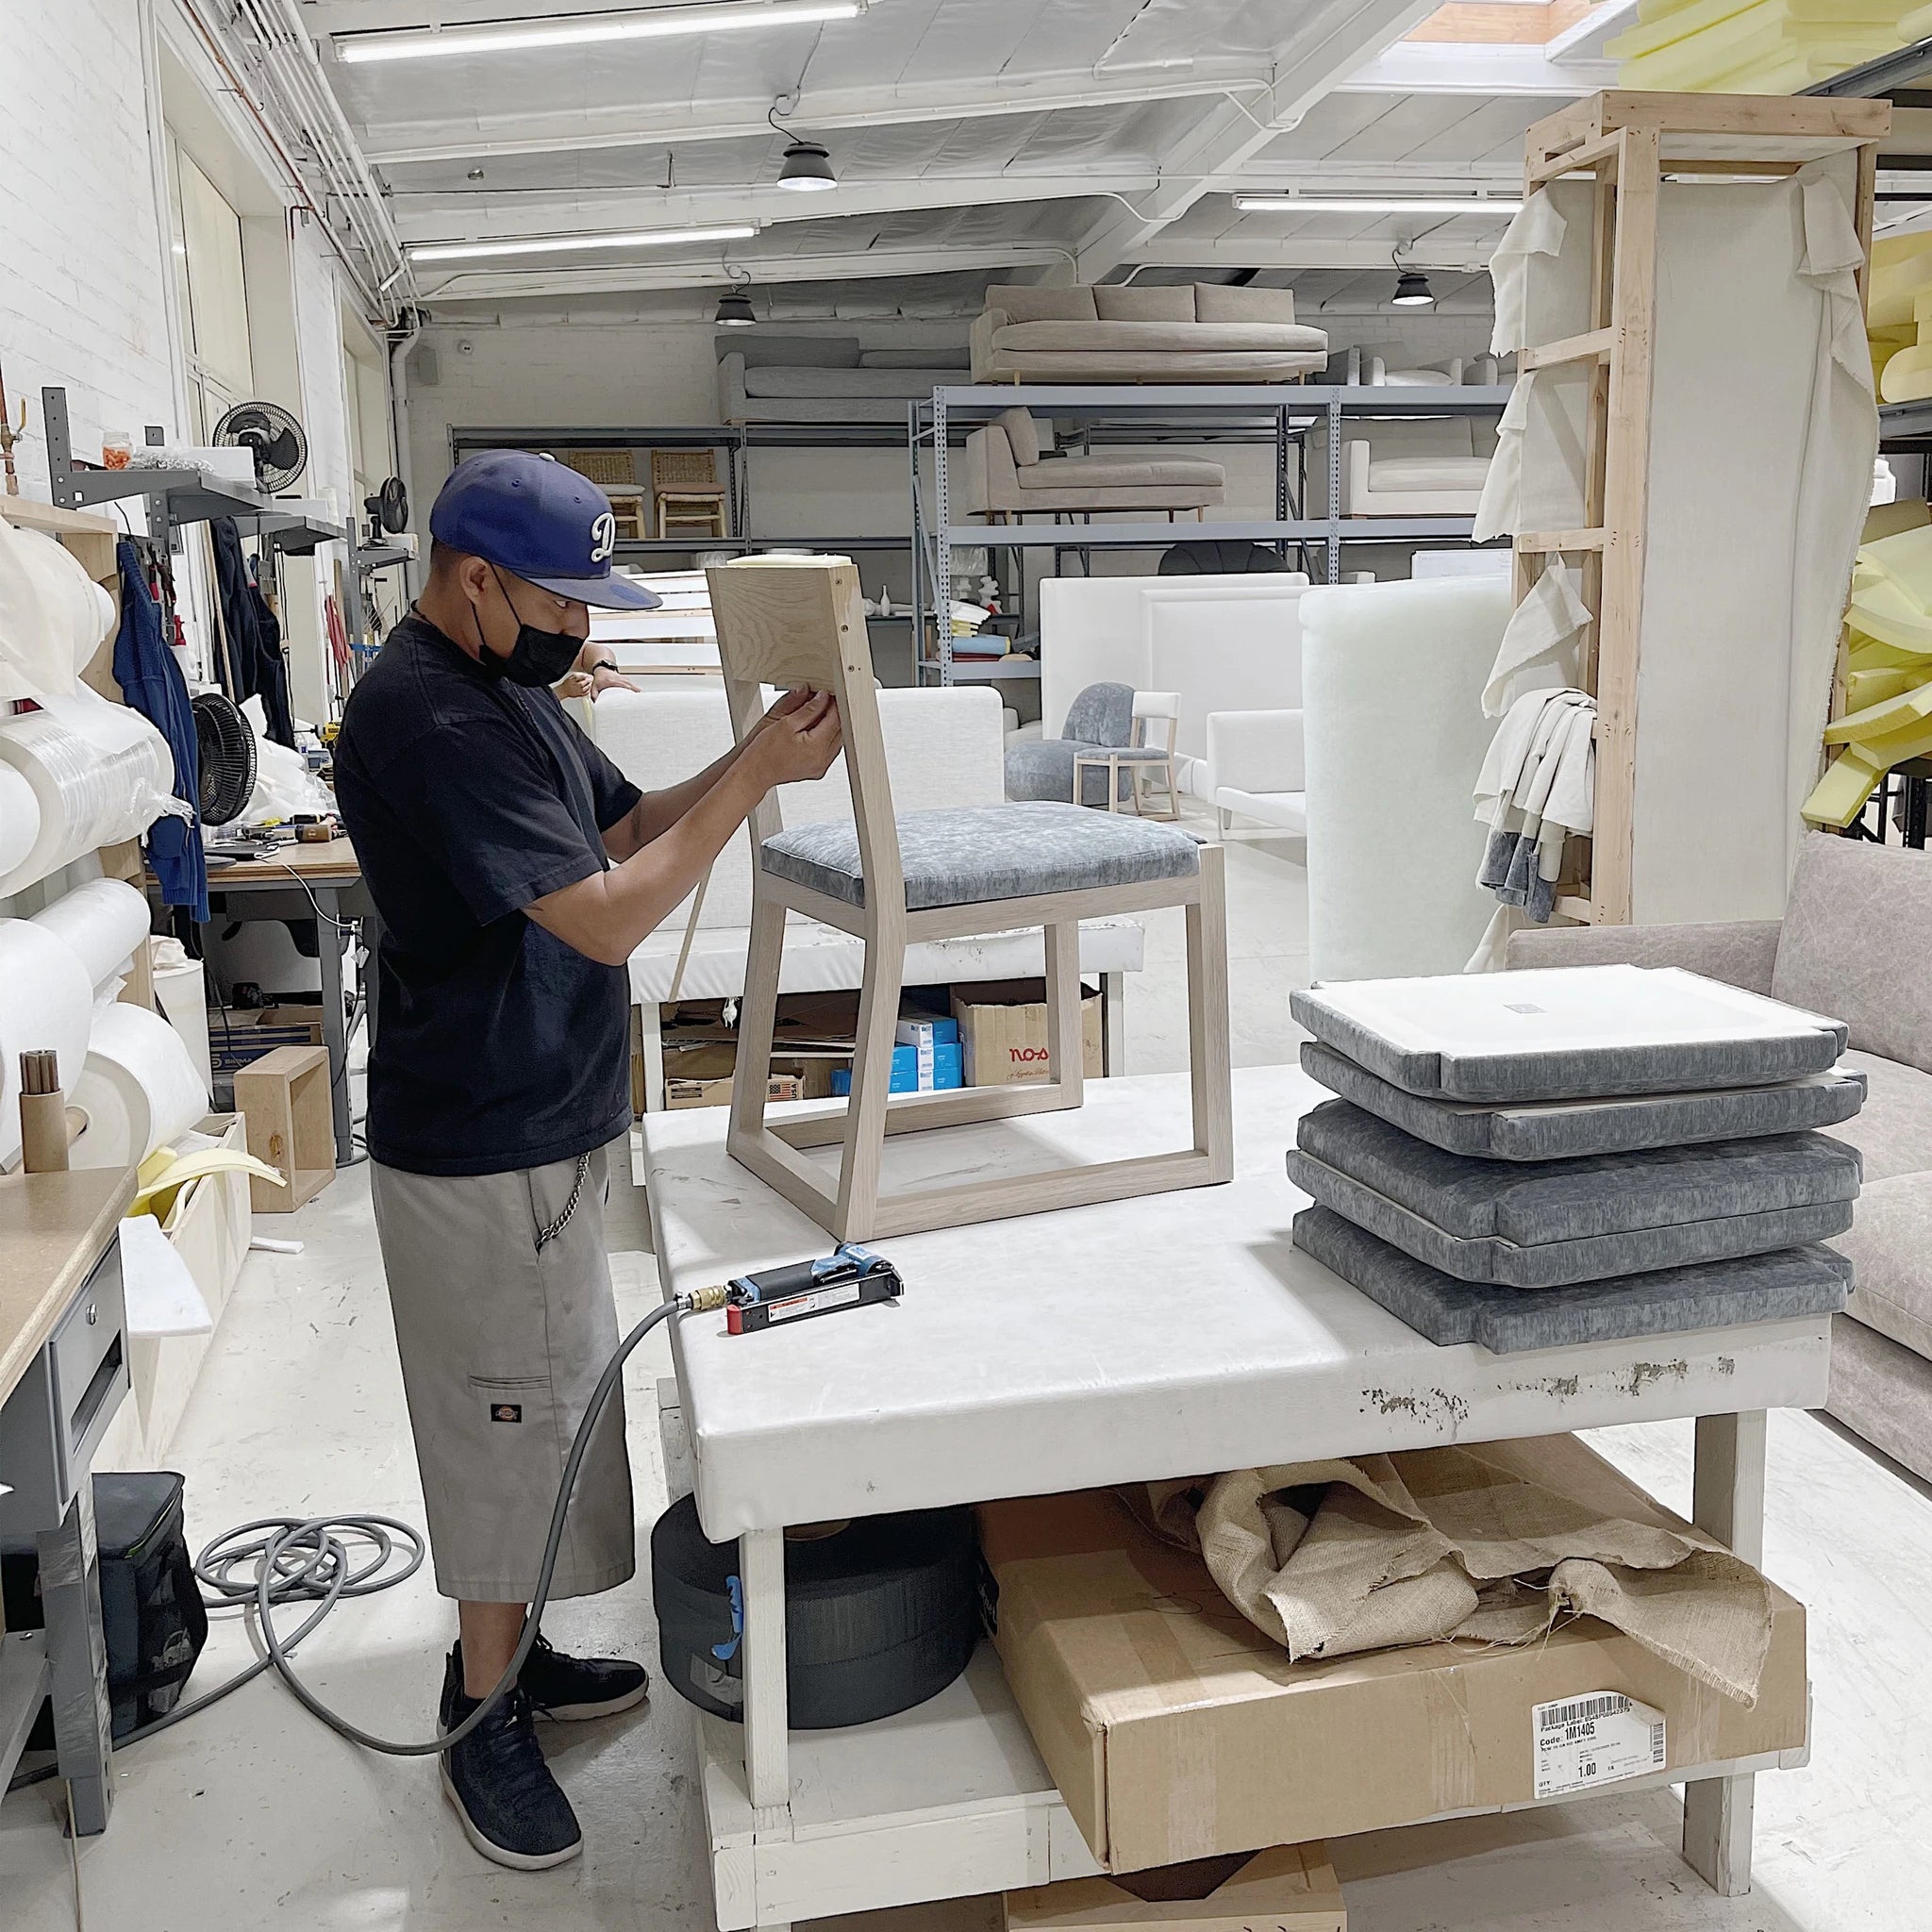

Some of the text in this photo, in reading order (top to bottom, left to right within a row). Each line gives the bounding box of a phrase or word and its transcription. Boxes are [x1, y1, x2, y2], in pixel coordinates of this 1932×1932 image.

[591, 512, 616, 562] D
[1540, 1736, 1564, 1746] Code:
[1565, 1722, 1595, 1740] 1M1405
[1541, 1722, 1565, 1733] Package
[1577, 1762, 1596, 1777] 1.00
